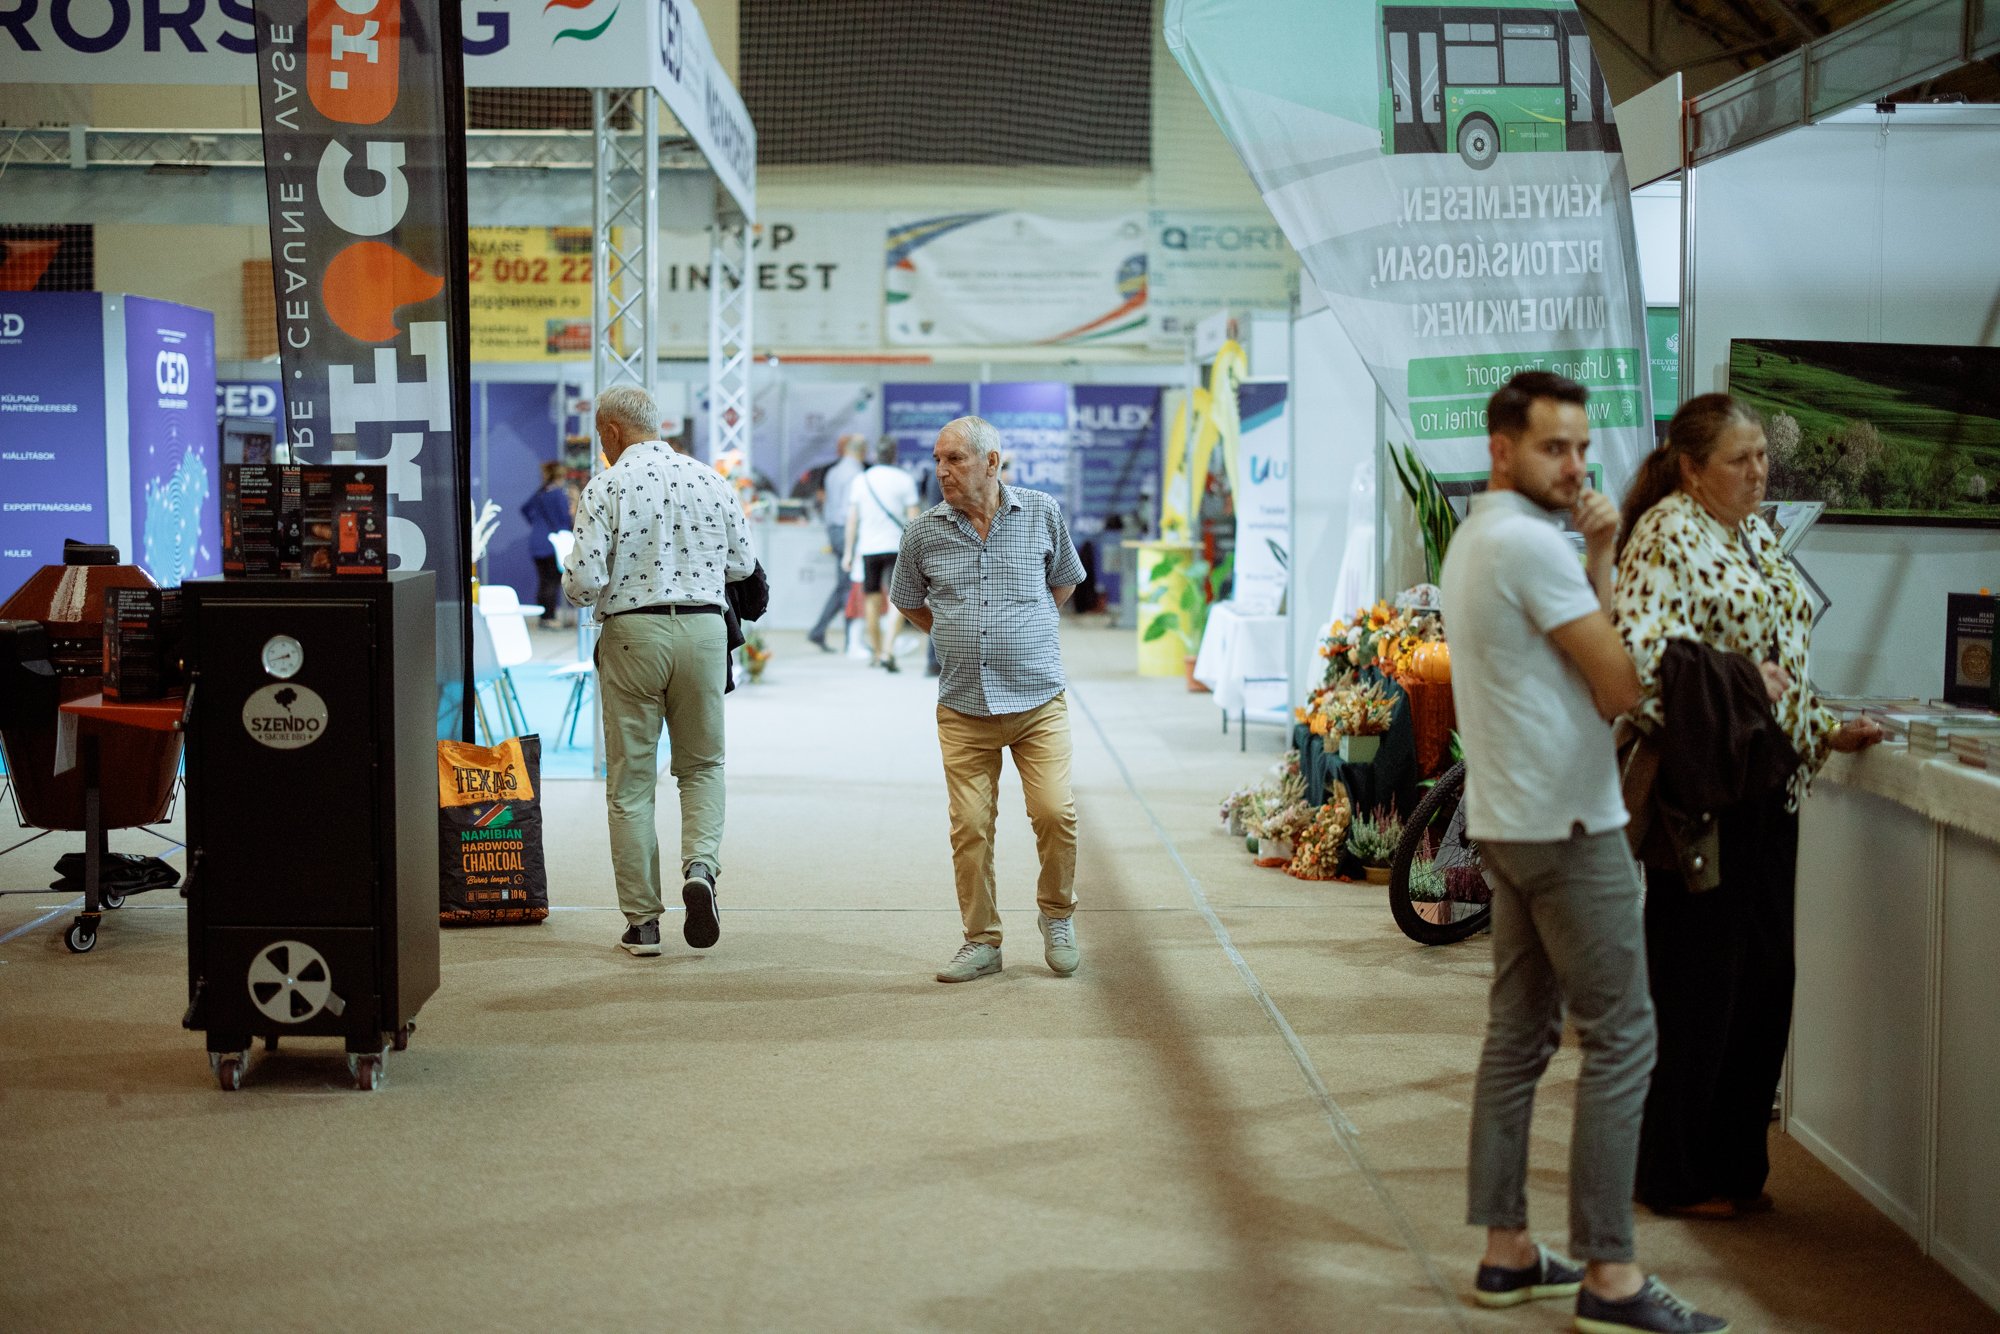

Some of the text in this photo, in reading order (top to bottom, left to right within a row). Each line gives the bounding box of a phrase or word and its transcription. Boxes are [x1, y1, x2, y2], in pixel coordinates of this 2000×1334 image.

[493, 257, 550, 283] 002
[669, 263, 838, 291] INVEST
[156, 350, 190, 395] CED
[1, 403, 78, 413] PARTNERKERESÉS
[2, 451, 56, 461] KIÁLLÍTÁSOK
[3, 502, 93, 513] EXPORTTANÁCSADÁS
[4, 549, 33, 558] HULEX
[252, 716, 320, 732] SZENDO
[453, 764, 518, 794] TEXAS
[461, 829, 522, 841] NAMIBIAN
[462, 841, 523, 853] HARDWOOD
[462, 851, 525, 873] CHARCOAL
[466, 874, 512, 885] Burns longer
